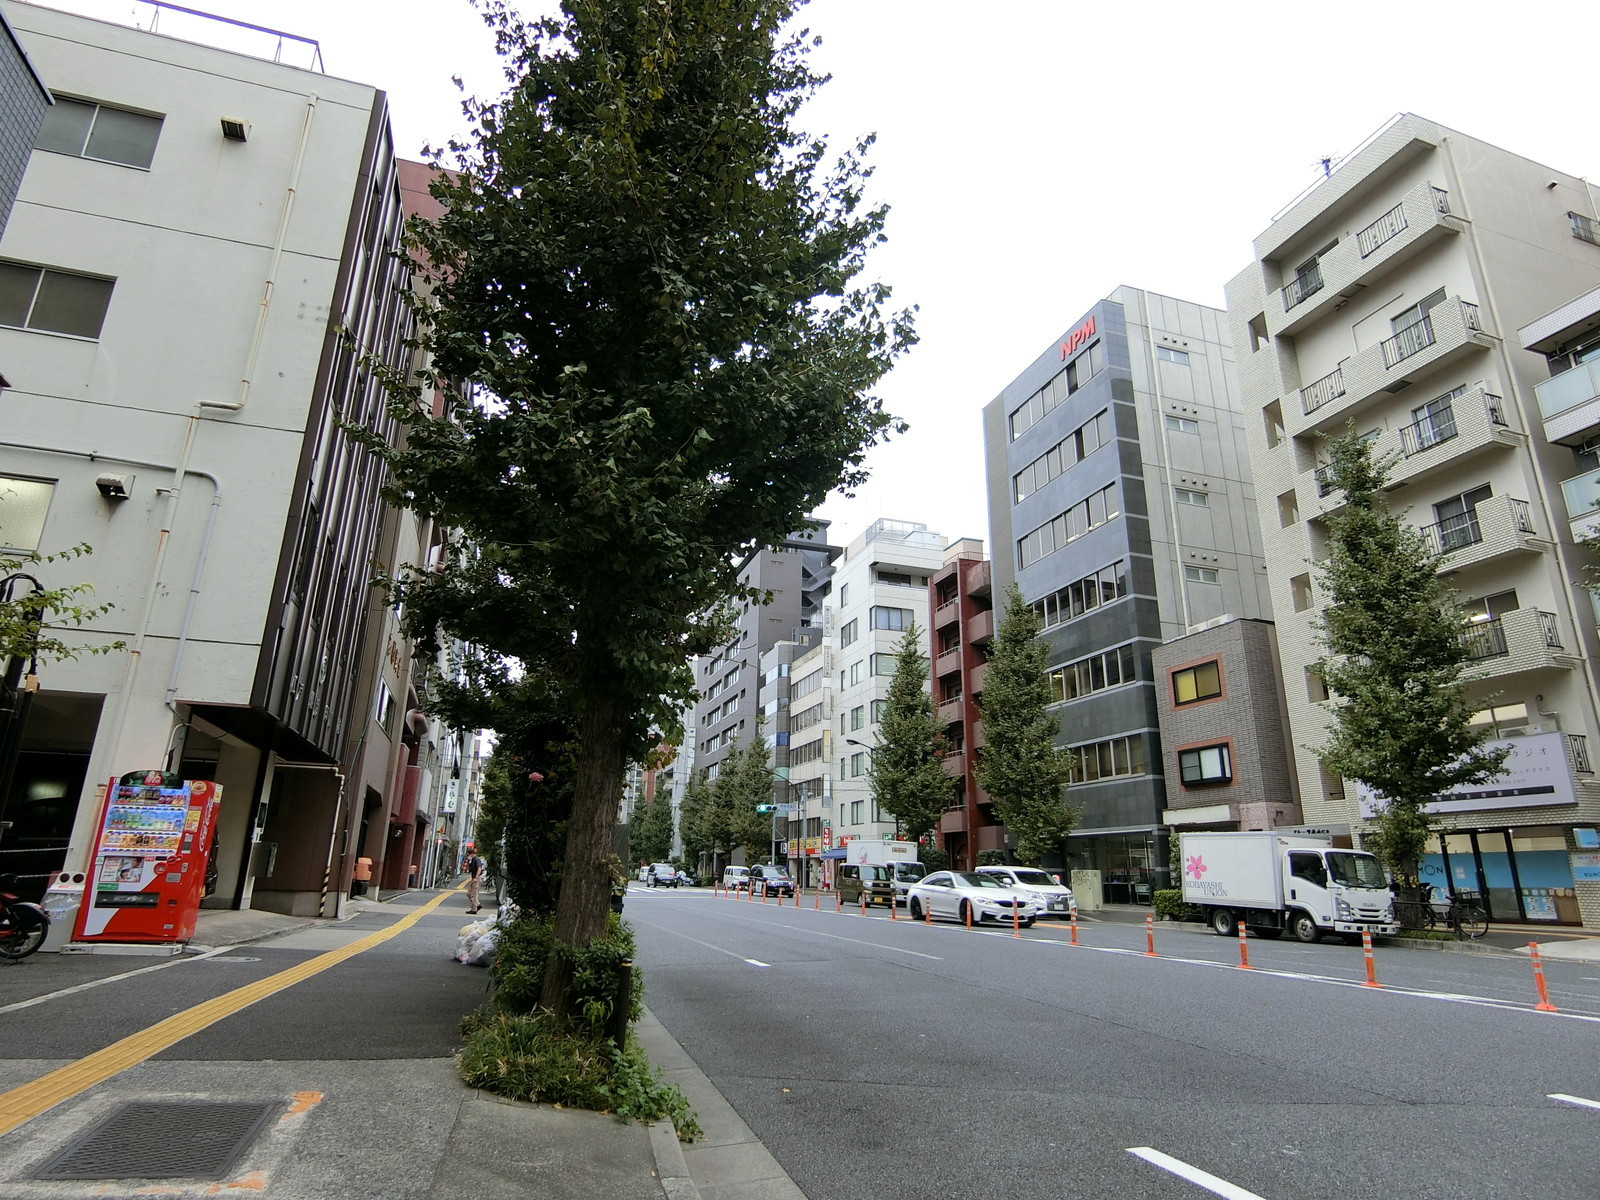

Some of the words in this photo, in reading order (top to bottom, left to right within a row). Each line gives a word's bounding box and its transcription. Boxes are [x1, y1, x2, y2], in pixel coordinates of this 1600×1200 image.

[1060, 315, 1096, 362] NPM
[1185, 880, 1223, 890] KOBAYASHI
[1203, 889, 1228, 897] UNION
